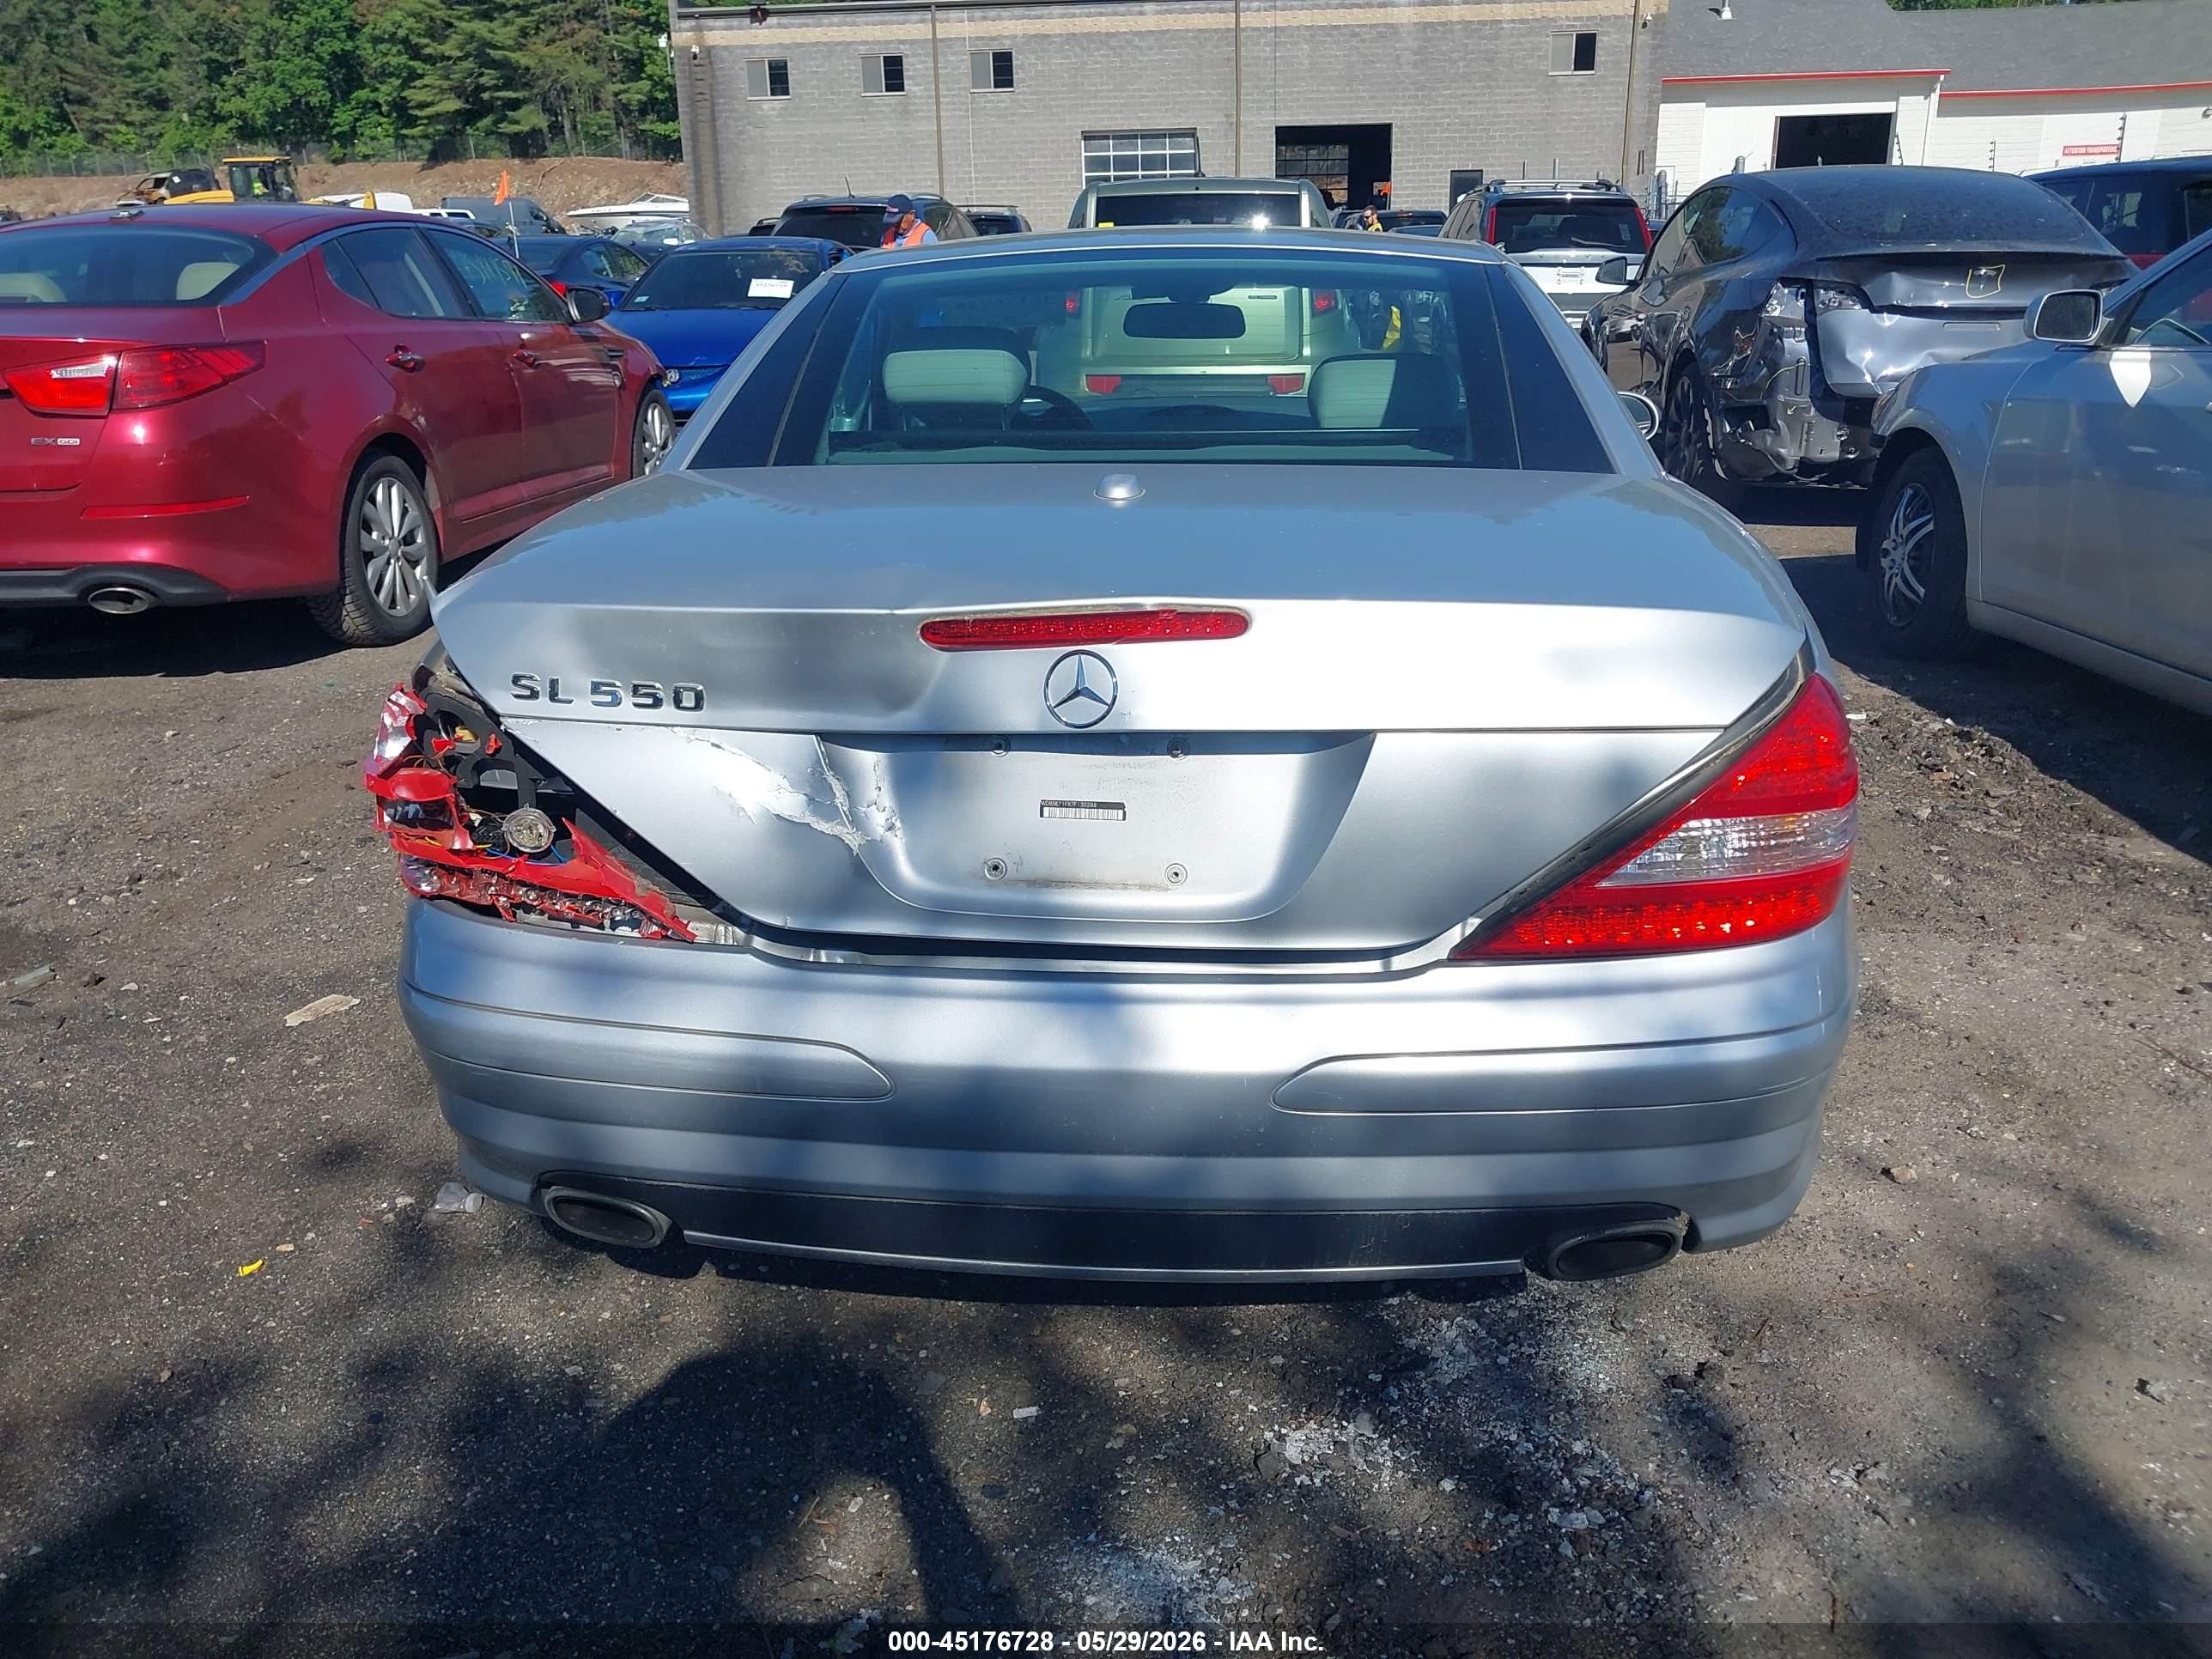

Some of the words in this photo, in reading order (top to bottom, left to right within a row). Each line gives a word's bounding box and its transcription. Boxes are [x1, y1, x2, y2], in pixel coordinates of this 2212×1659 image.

[31, 437, 56, 446] EX
[510, 672, 574, 705] SL
[590, 678, 706, 713] 550
